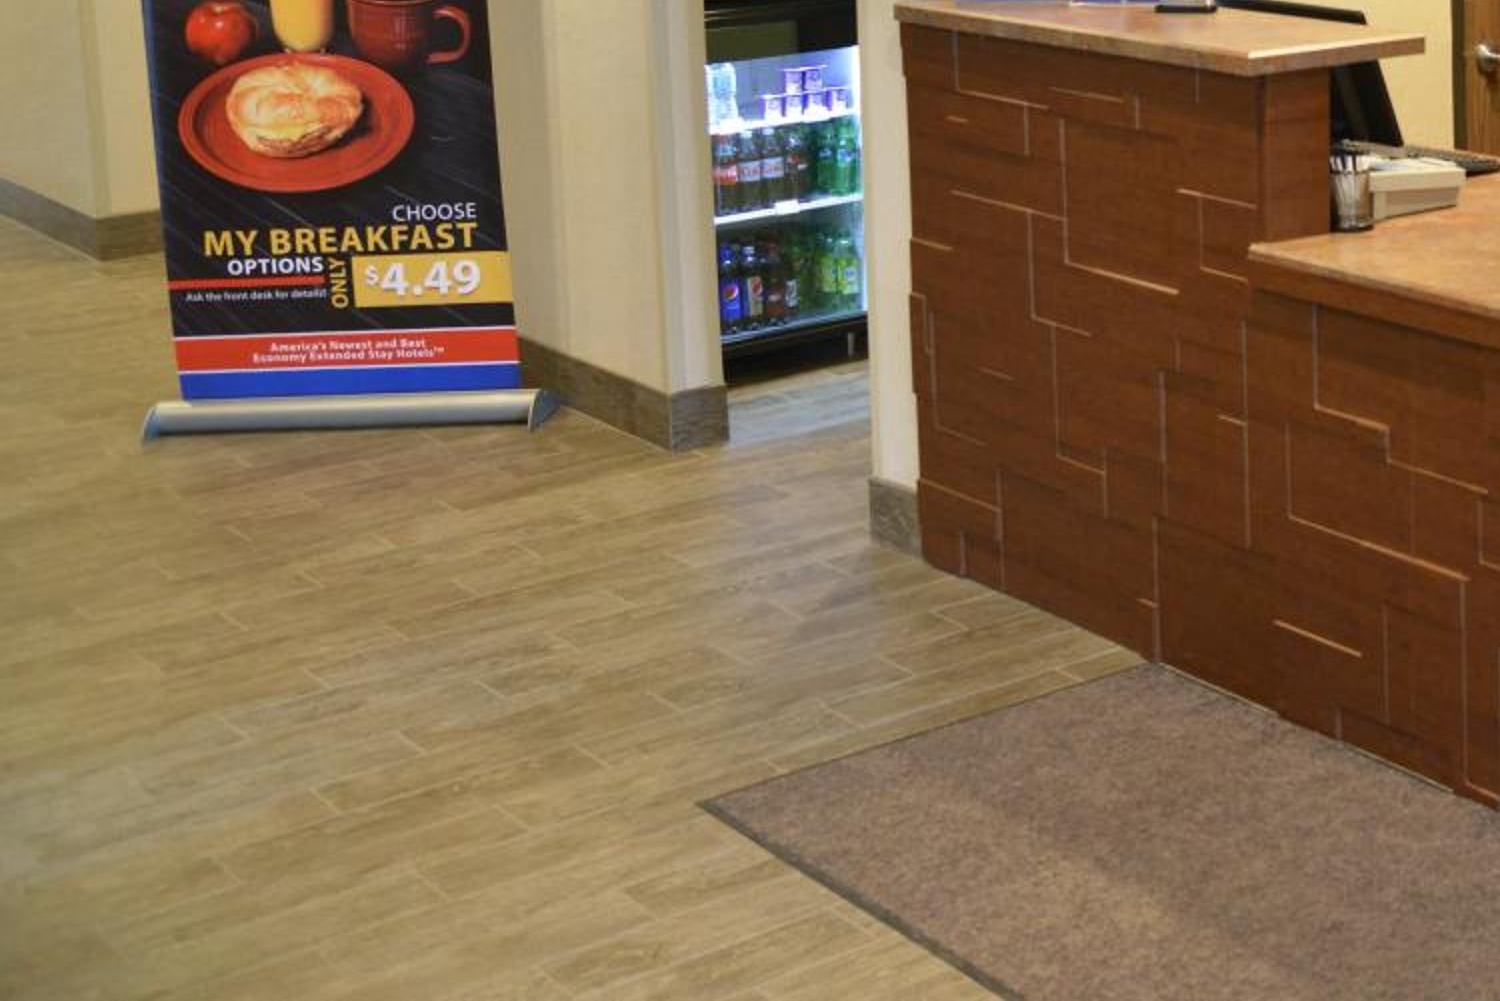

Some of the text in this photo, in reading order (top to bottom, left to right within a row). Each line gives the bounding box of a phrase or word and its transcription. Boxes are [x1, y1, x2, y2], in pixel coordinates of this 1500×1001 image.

[392, 203, 477, 221] CHOOSE
[204, 222, 478, 257] MY BREAKFAST
[227, 257, 324, 276] OPTIONS
[327, 257, 481, 309] ONLY $4.49
[186, 293, 204, 302] Ask
[205, 292, 222, 301] the
[224, 291, 248, 300] front
[250, 291, 273, 300] desk
[275, 290, 288, 298] for
[270, 338, 427, 352] America's Newest and Best
[253, 352, 306, 364] Economy
[309, 351, 365, 362] Extended
[367, 349, 393, 361] Stay
